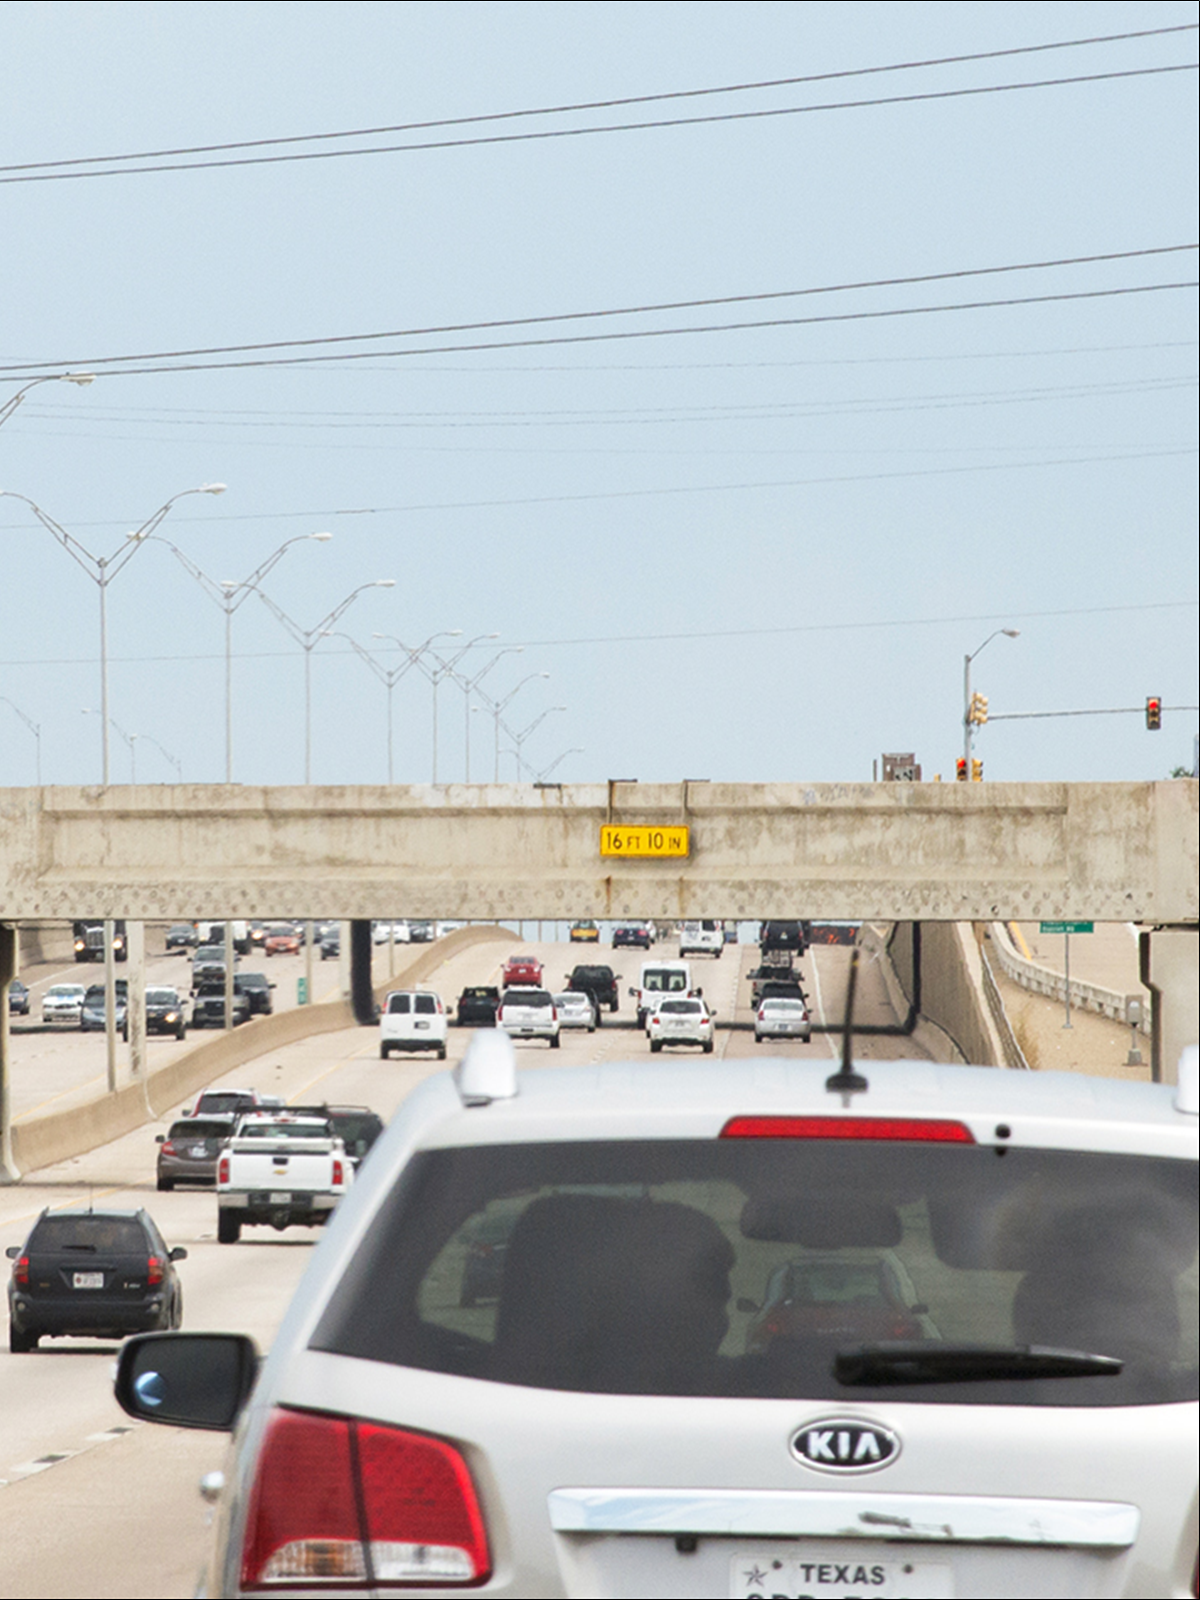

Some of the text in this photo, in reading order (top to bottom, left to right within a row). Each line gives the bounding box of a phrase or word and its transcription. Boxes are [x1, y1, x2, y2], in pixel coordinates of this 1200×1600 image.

[607, 832, 681, 849] 16 FT 10 IN
[808, 1430, 882, 1460] KIA
[800, 1563, 886, 1586] TEXAS
